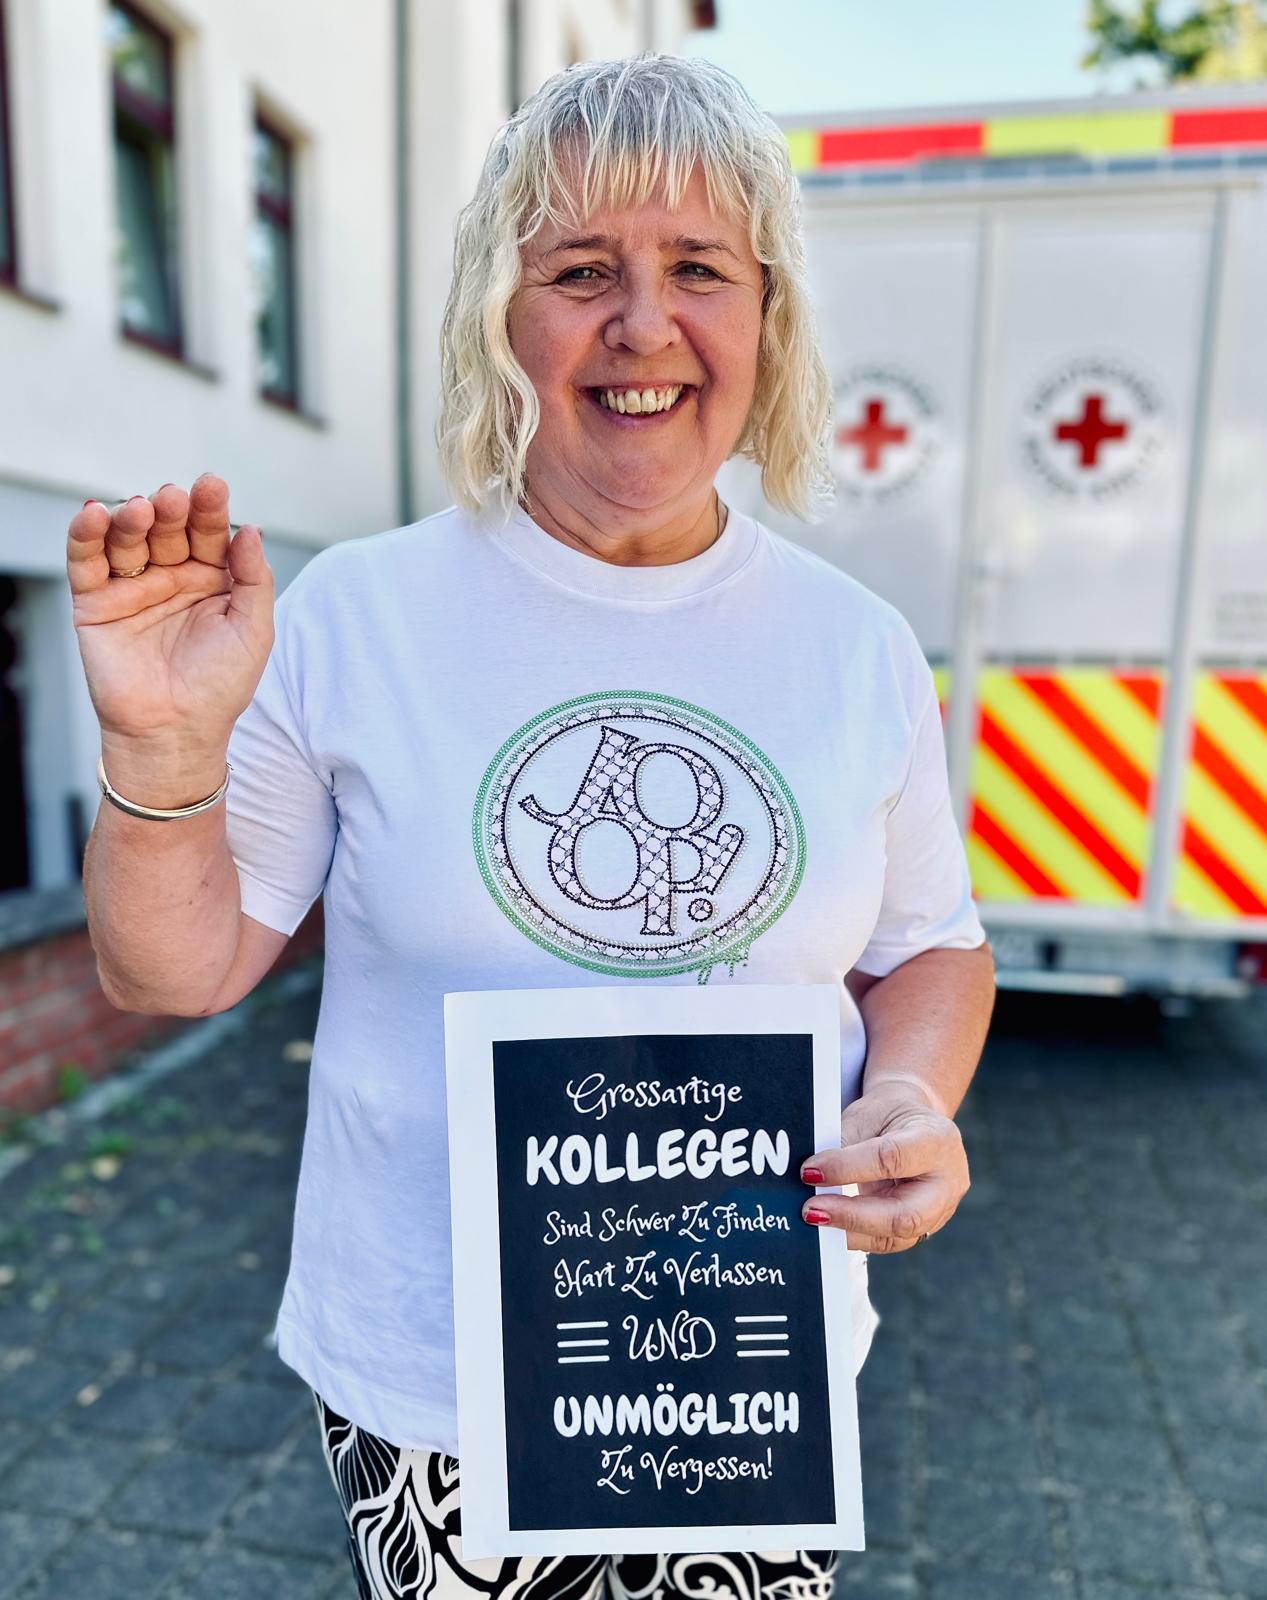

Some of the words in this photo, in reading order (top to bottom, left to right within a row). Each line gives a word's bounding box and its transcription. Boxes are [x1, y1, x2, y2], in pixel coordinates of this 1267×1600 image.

[567, 1073, 742, 1121] Grossartige
[527, 1128, 790, 1185] KOLLEGEN
[544, 1211, 593, 1245] Sind
[599, 1204, 675, 1241] Schwer
[678, 1201, 710, 1242] Zu
[715, 1203, 790, 1235] Finden
[554, 1259, 615, 1298] Hart
[621, 1251, 658, 1300] Zu
[663, 1252, 785, 1295] Verlassen
[622, 1310, 716, 1361] UND
[554, 1383, 799, 1437] UNMÖGLICH
[597, 1445, 634, 1494] Zu
[640, 1446, 772, 1494] Vergessen!
